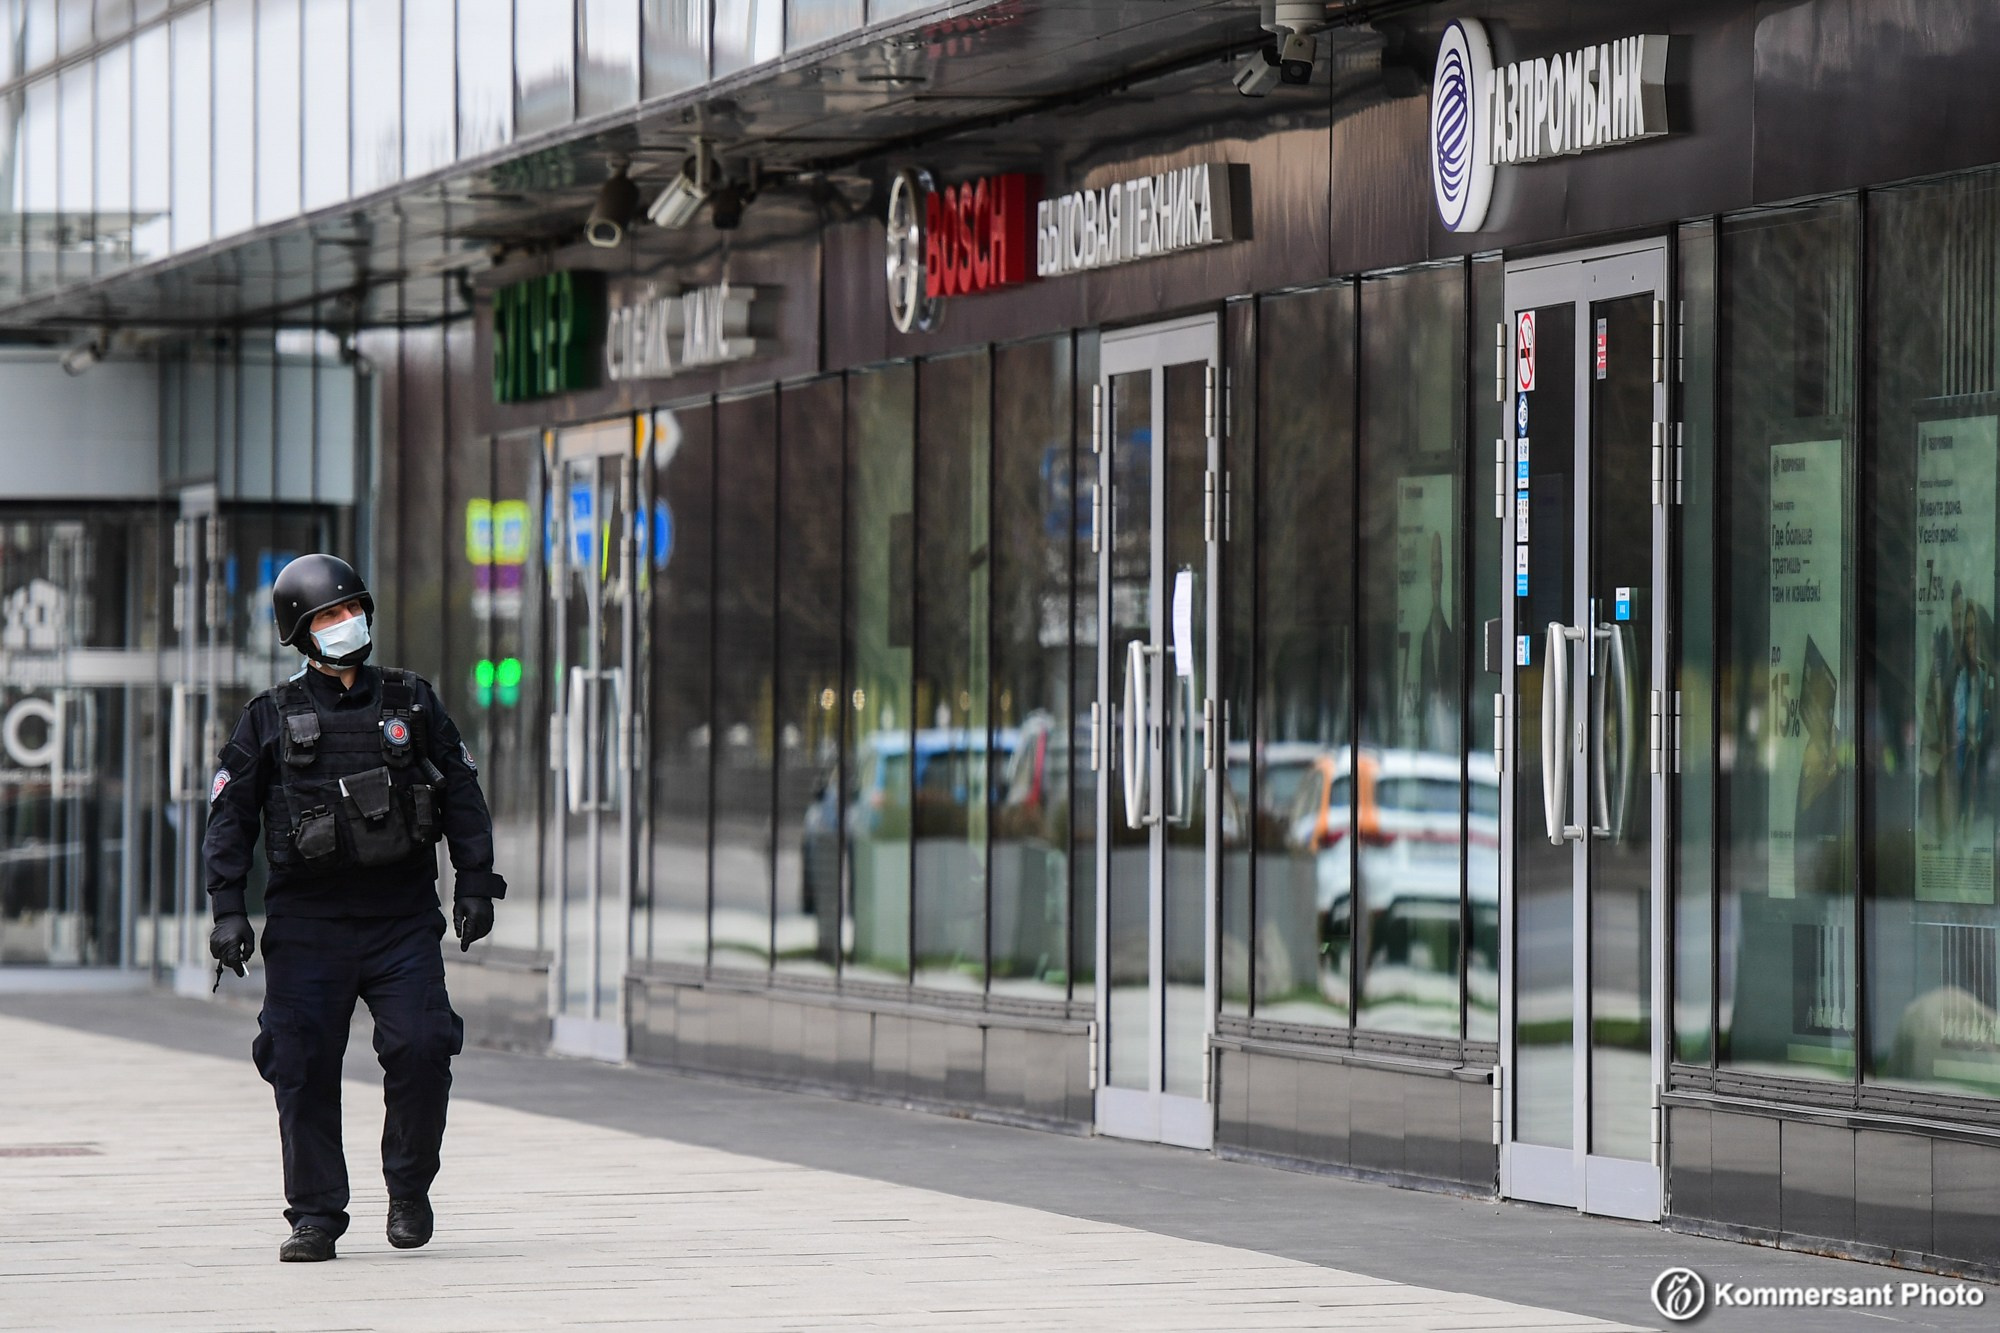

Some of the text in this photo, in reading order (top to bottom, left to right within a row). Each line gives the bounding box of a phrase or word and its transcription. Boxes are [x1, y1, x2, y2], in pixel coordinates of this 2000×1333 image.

[1486, 34, 1645, 166] ГАЗПРОМБАНК
[926, 176, 1007, 298] BOSCH
[1037, 162, 1213, 277] БЫТОВАЯ ТЕХНИКА
[1771, 521, 1813, 550] Где больше
[1772, 556, 1801, 580] тратишь
[1772, 585, 1784, 603] там
[1771, 646, 1781, 667] до
[1771, 672, 1801, 738] 15%
